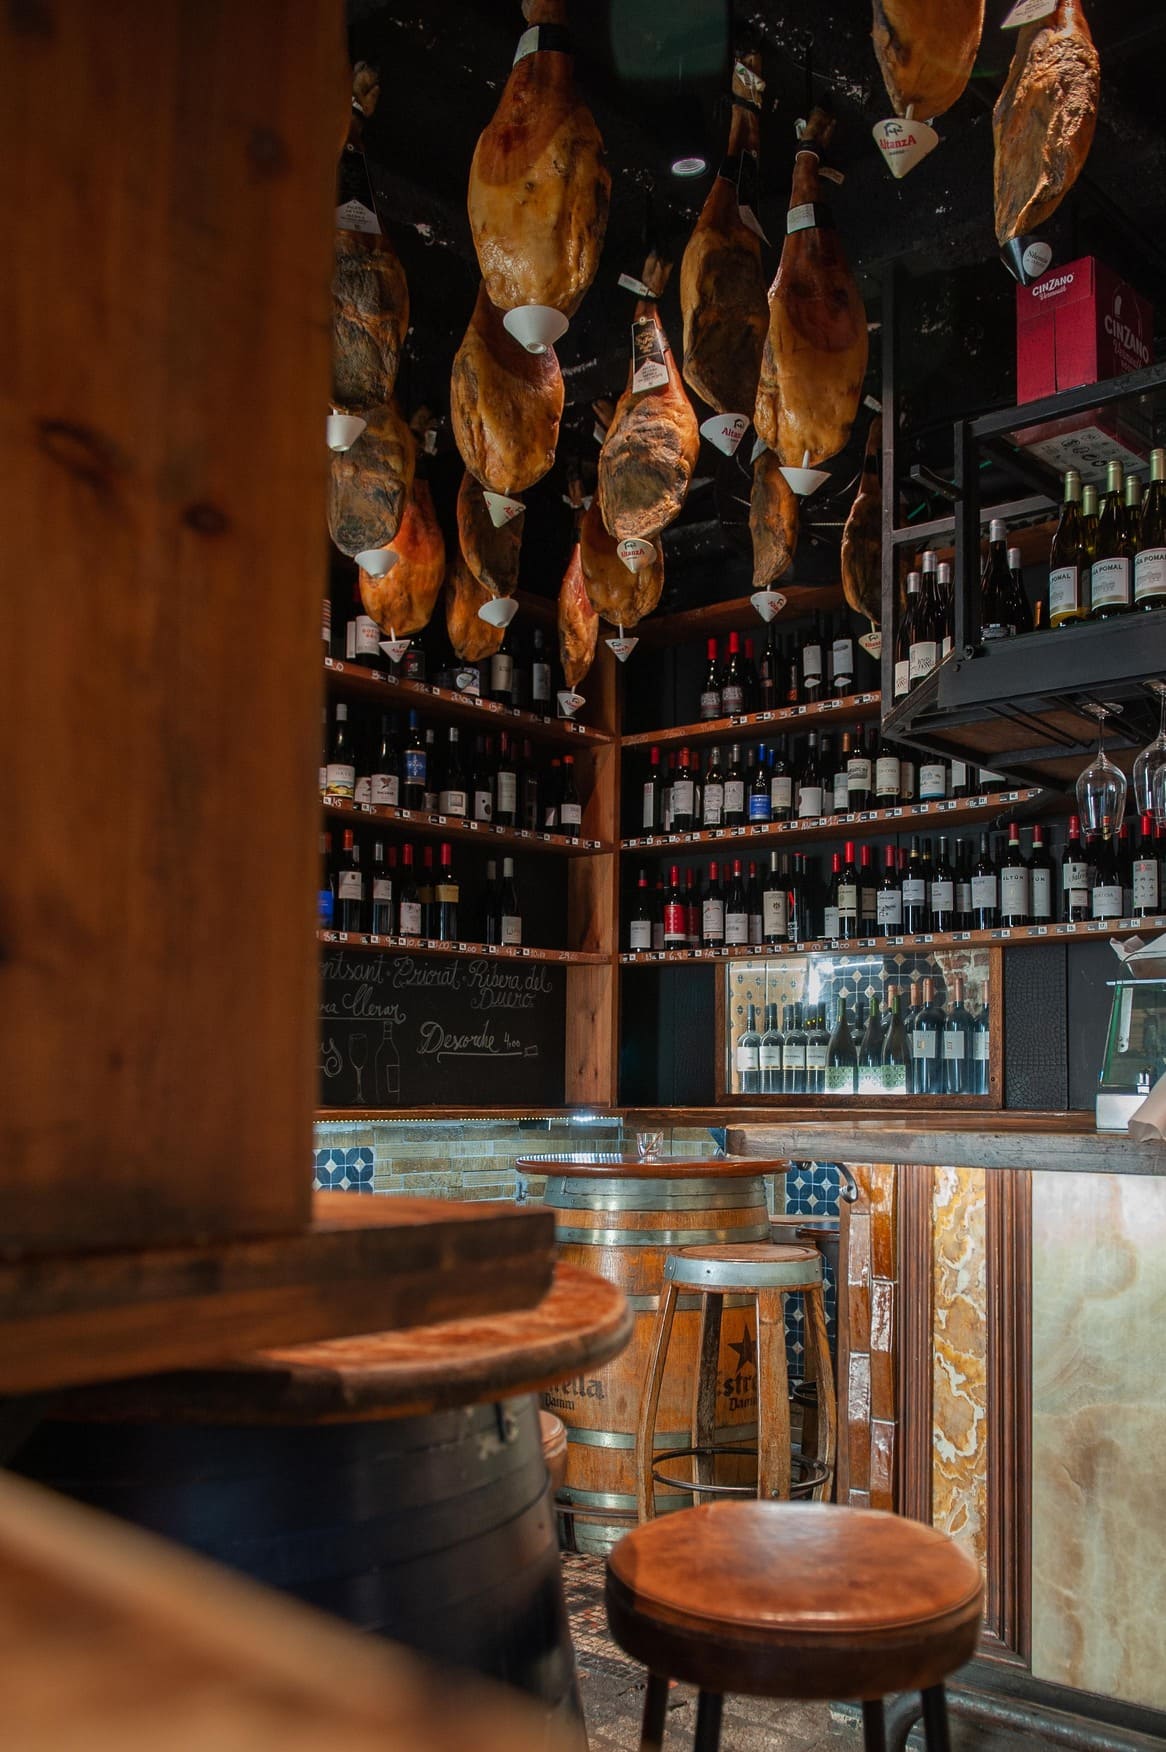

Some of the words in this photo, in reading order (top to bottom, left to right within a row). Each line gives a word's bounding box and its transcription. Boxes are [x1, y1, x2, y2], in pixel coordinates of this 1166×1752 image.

[1031, 273, 1074, 297] CINZANO
[1103, 314, 1149, 364] CINZANO
[1099, 564, 1123, 573] POMAL
[320, 951, 387, 983] ntsant
[392, 956, 461, 990] Priorat
[468, 959, 521, 990] Ribera
[524, 964, 553, 993] del
[471, 987, 536, 1010] Duero
[545, 1392, 575, 1411] Damm
